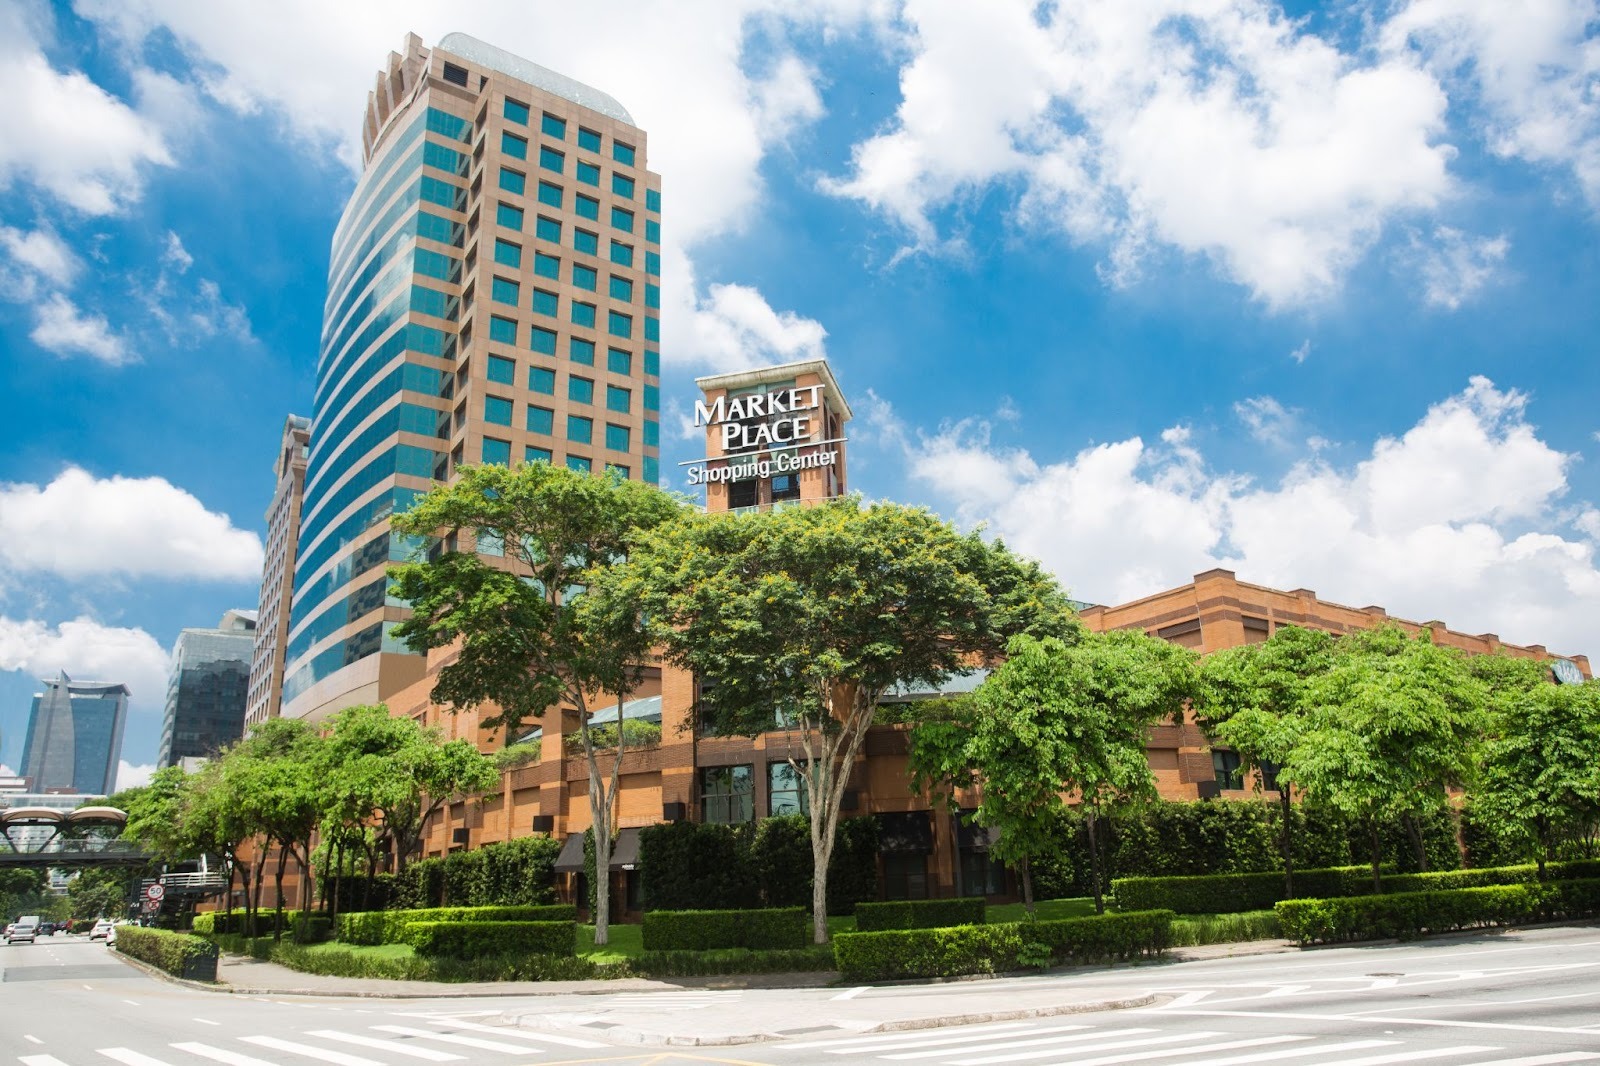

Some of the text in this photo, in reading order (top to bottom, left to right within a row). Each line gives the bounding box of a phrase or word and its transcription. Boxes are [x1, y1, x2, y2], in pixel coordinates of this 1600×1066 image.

[694, 384, 825, 427] MARKET
[721, 416, 811, 451] PLACE
[687, 451, 838, 486] Shopping Center
[150, 887, 162, 895] 50
